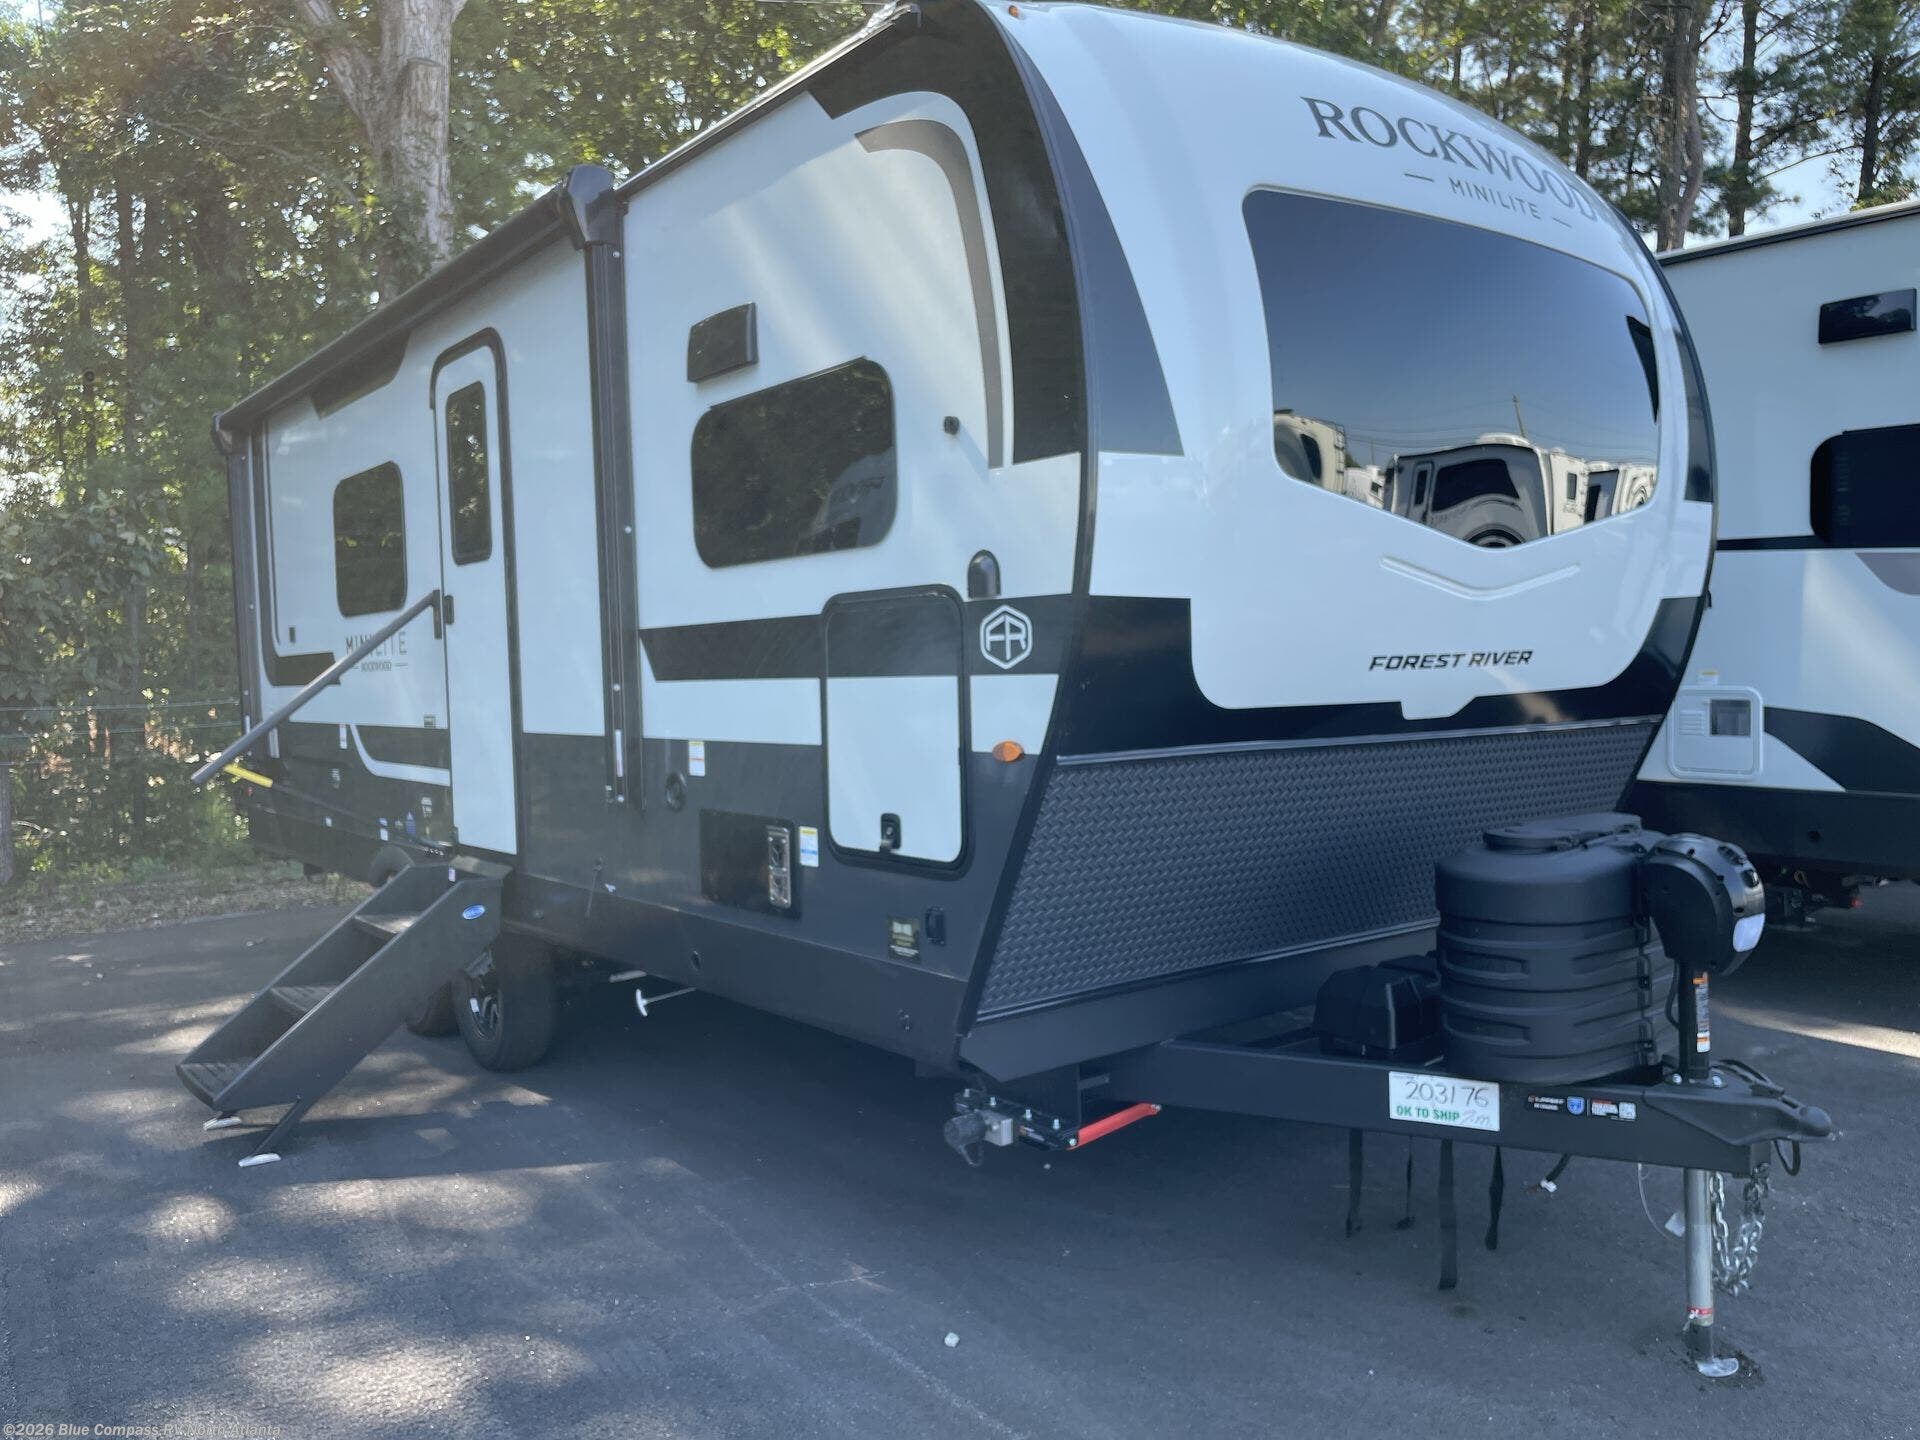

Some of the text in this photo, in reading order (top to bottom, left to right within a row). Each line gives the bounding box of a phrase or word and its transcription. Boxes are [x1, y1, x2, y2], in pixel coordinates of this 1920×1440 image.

[1300, 96, 1598, 222] ROCKWOOD
[1448, 176, 1542, 220] MINILITE
[1368, 650, 1533, 671] FOREST RIVER
[1396, 1105, 1460, 1122] OK TO SHIP
